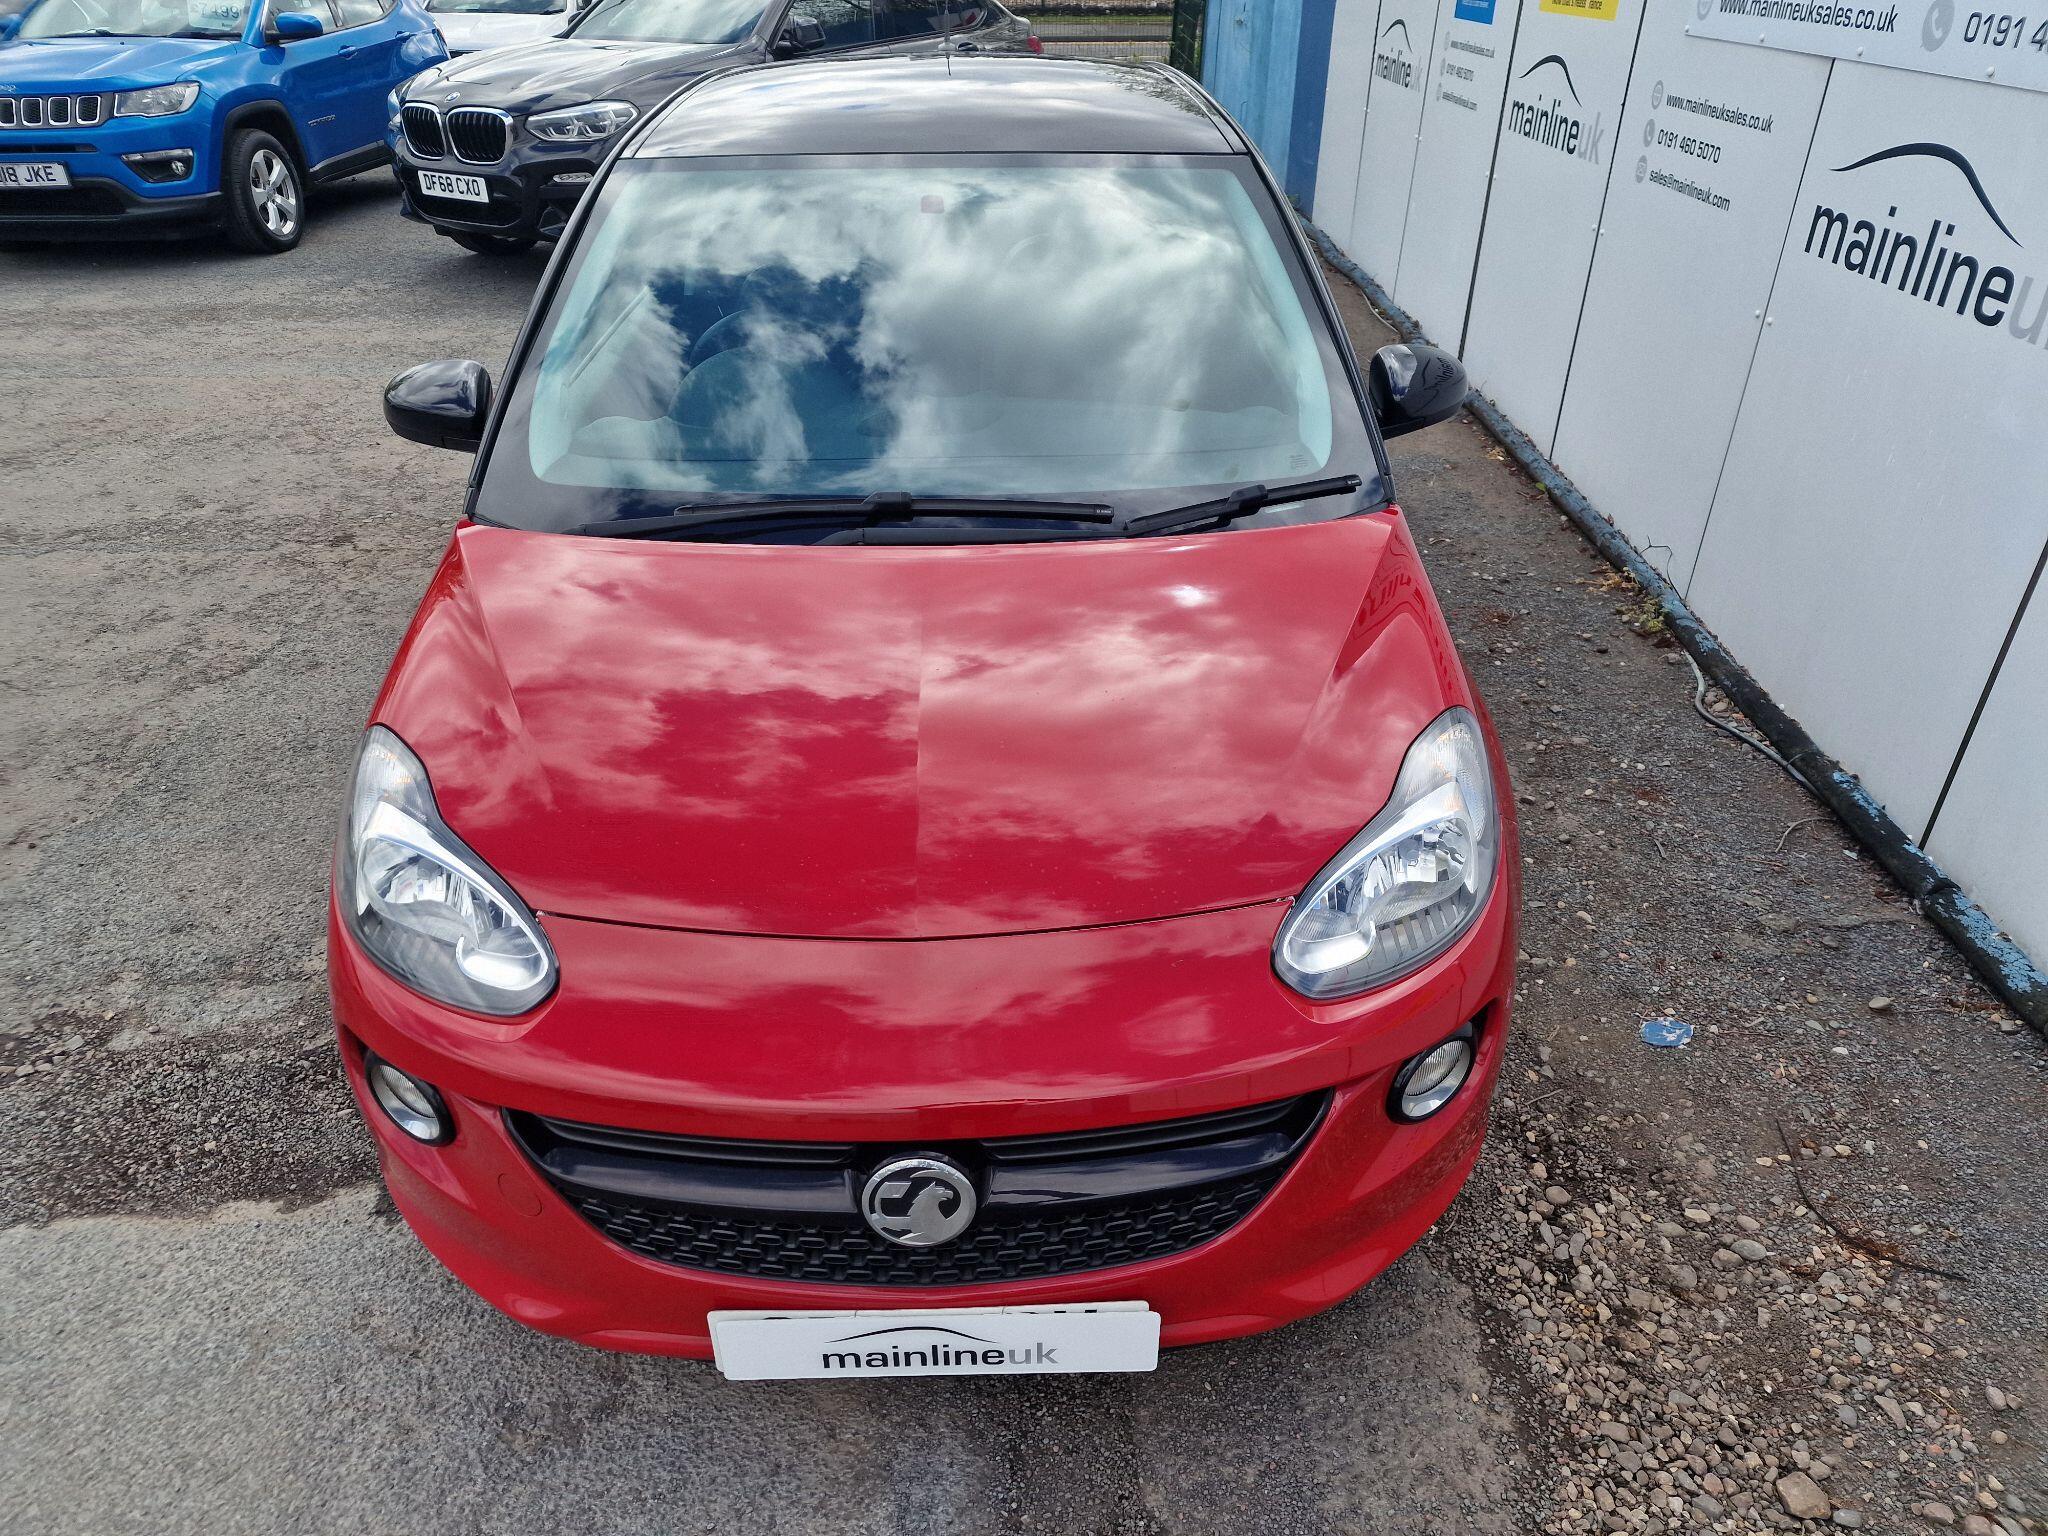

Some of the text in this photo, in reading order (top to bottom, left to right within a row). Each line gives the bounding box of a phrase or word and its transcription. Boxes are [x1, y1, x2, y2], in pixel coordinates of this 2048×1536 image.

[1718, 0, 1898, 33] www.mainlineuksales.co.uk
[1963, 11, 2027, 49] 0191
[1375, 47, 1423, 93] mainlineuk
[1508, 94, 1605, 165] mainlineuk
[1666, 94, 1774, 133] www.mainlineuksales.co.uk
[1657, 128, 1721, 164] 0191 460 5070
[24, 165, 57, 182] JKE
[423, 173, 481, 197] DF68 CXO
[1649, 168, 1731, 212] sales@mainlineuk.com
[1804, 205, 2048, 351] mainlineu
[822, 1342, 1059, 1369] mainlineuk
